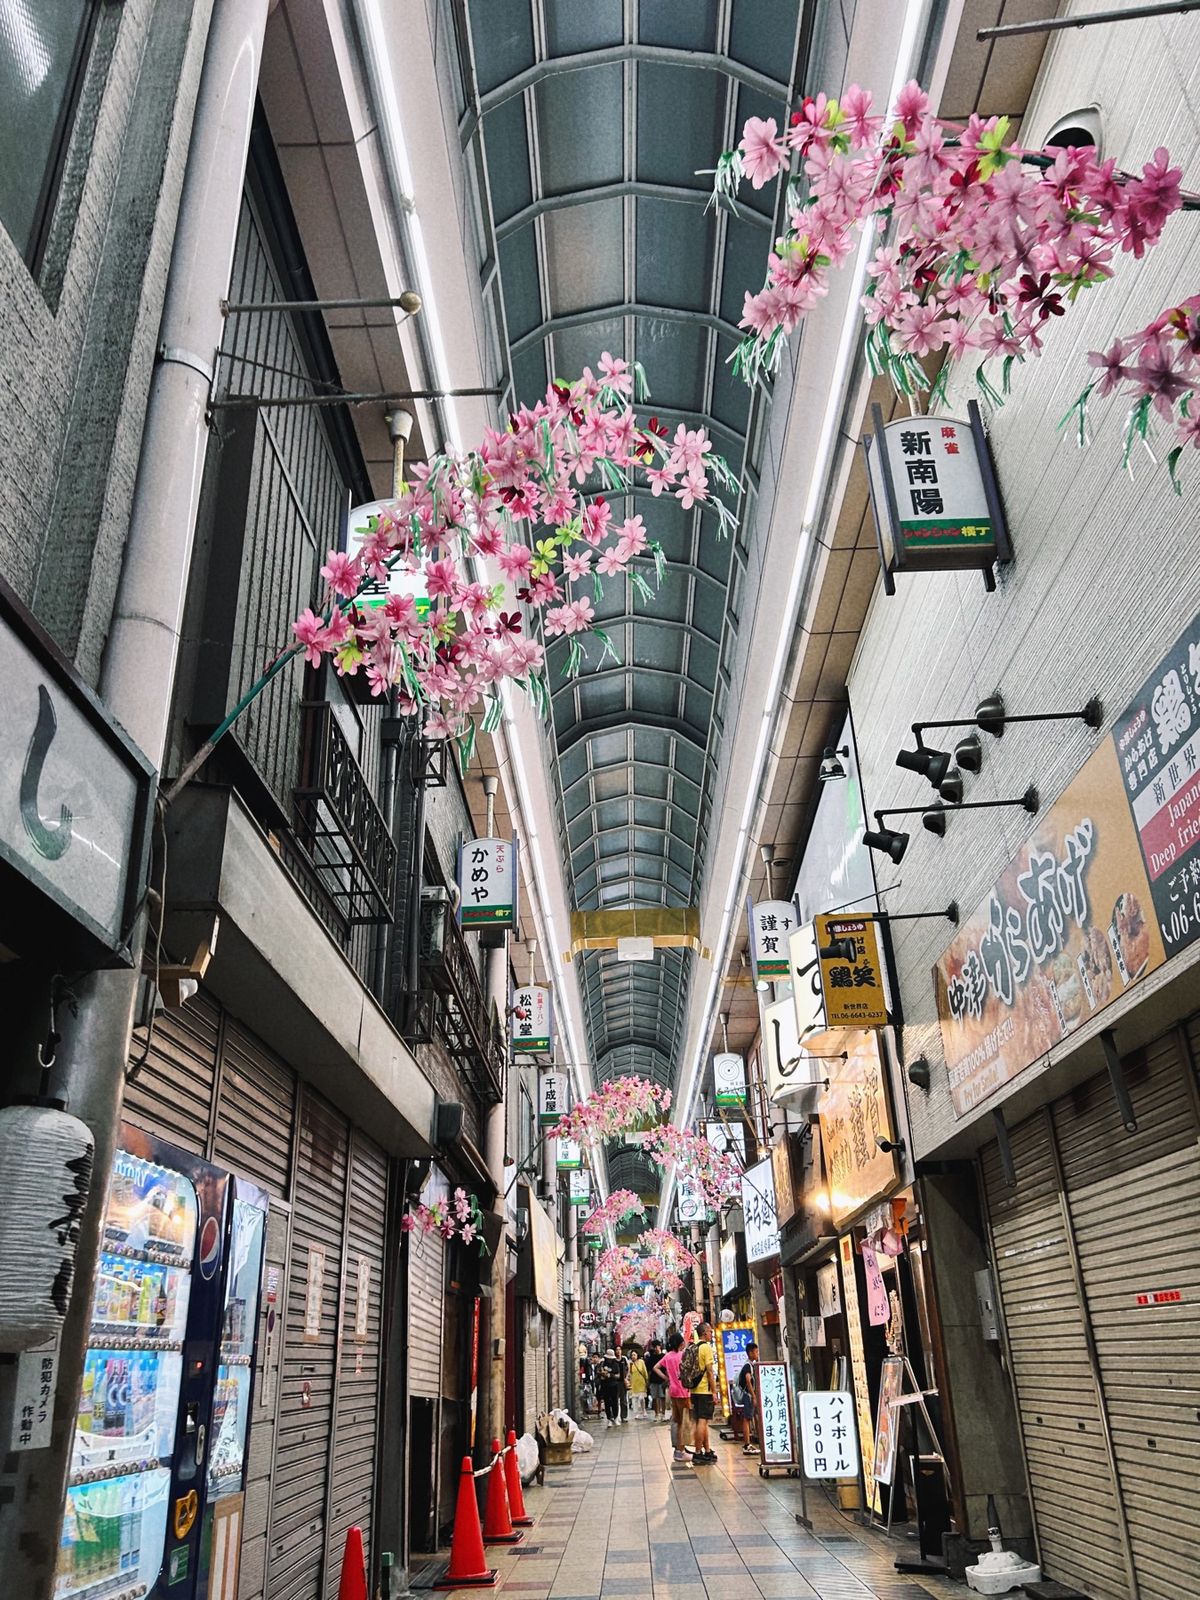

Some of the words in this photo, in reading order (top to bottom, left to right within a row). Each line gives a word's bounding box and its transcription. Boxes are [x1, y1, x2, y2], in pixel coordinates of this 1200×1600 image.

[941, 426, 960, 455] 麻雀
[900, 430, 944, 516] 新南陽
[1124, 727, 1153, 773] からあげ
[1128, 747, 1159, 791] 専門店
[1152, 742, 1197, 806] 新世界
[471, 848, 489, 903] かめや
[496, 845, 505, 873] 天ぷら
[1150, 842, 1177, 873] Deep
[760, 914, 779, 953] 謹賀
[979, 817, 1093, 1005] からあげ
[829, 966, 876, 988] 鶏笑
[545, 1078, 557, 1112] 千成屋
[38, 1357, 54, 1423] 防犯カメラ
[760, 1366, 784, 1377] 小さな
[19, 1405, 33, 1446] 作動中
[763, 1396, 777, 1453] あります
[775, 1379, 790, 1452] 子供用弓矢
[829, 1396, 850, 1472] ハイボール
[813, 1406, 828, 1472] 190円
